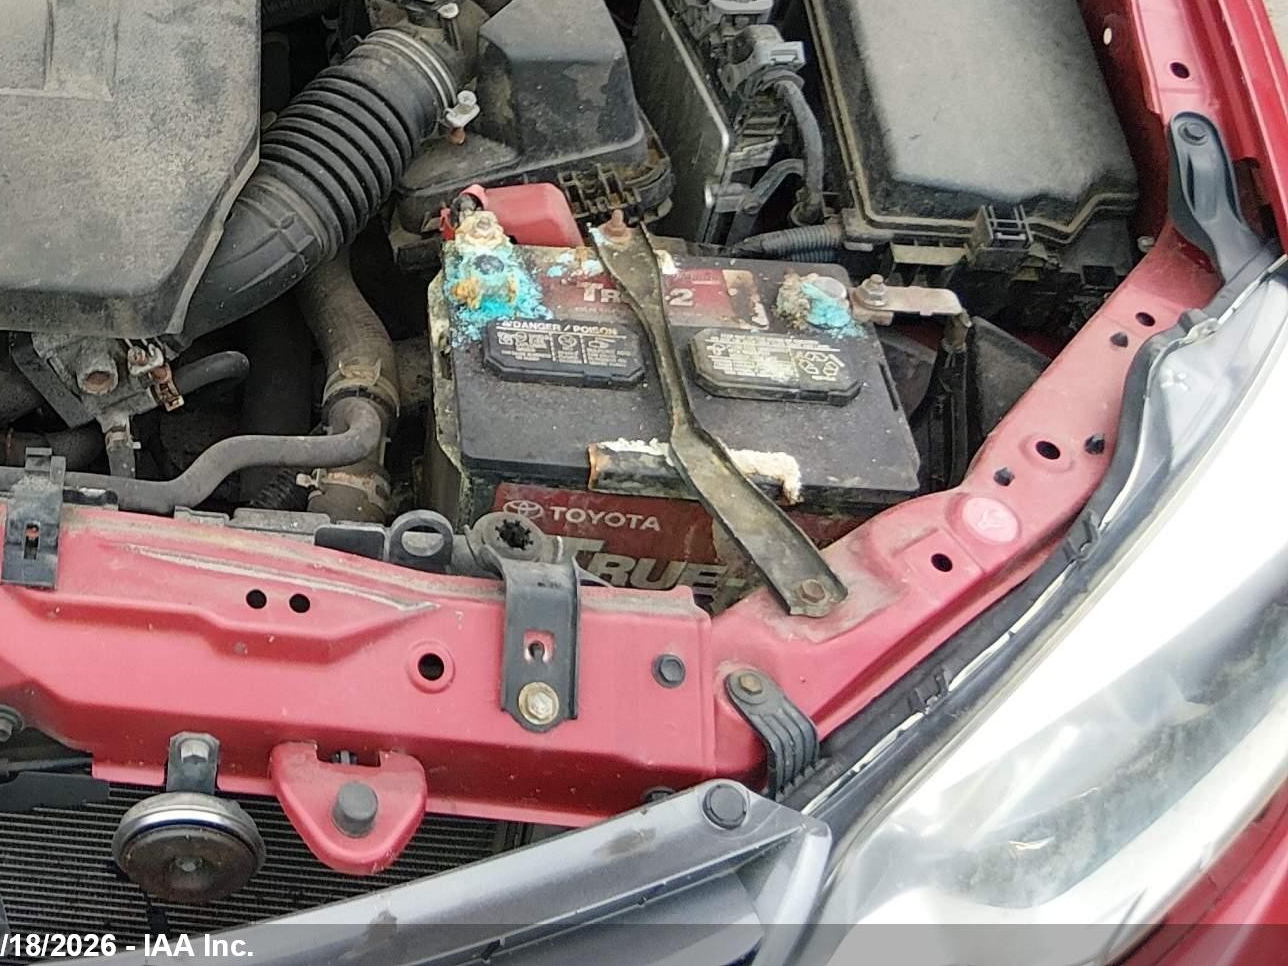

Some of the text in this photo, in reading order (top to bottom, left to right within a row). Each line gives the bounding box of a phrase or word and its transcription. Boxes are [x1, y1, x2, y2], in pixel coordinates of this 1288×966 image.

[513, 321, 561, 332] DANGER
[572, 325, 618, 336] POISON
[550, 506, 660, 532] TOYOTA
